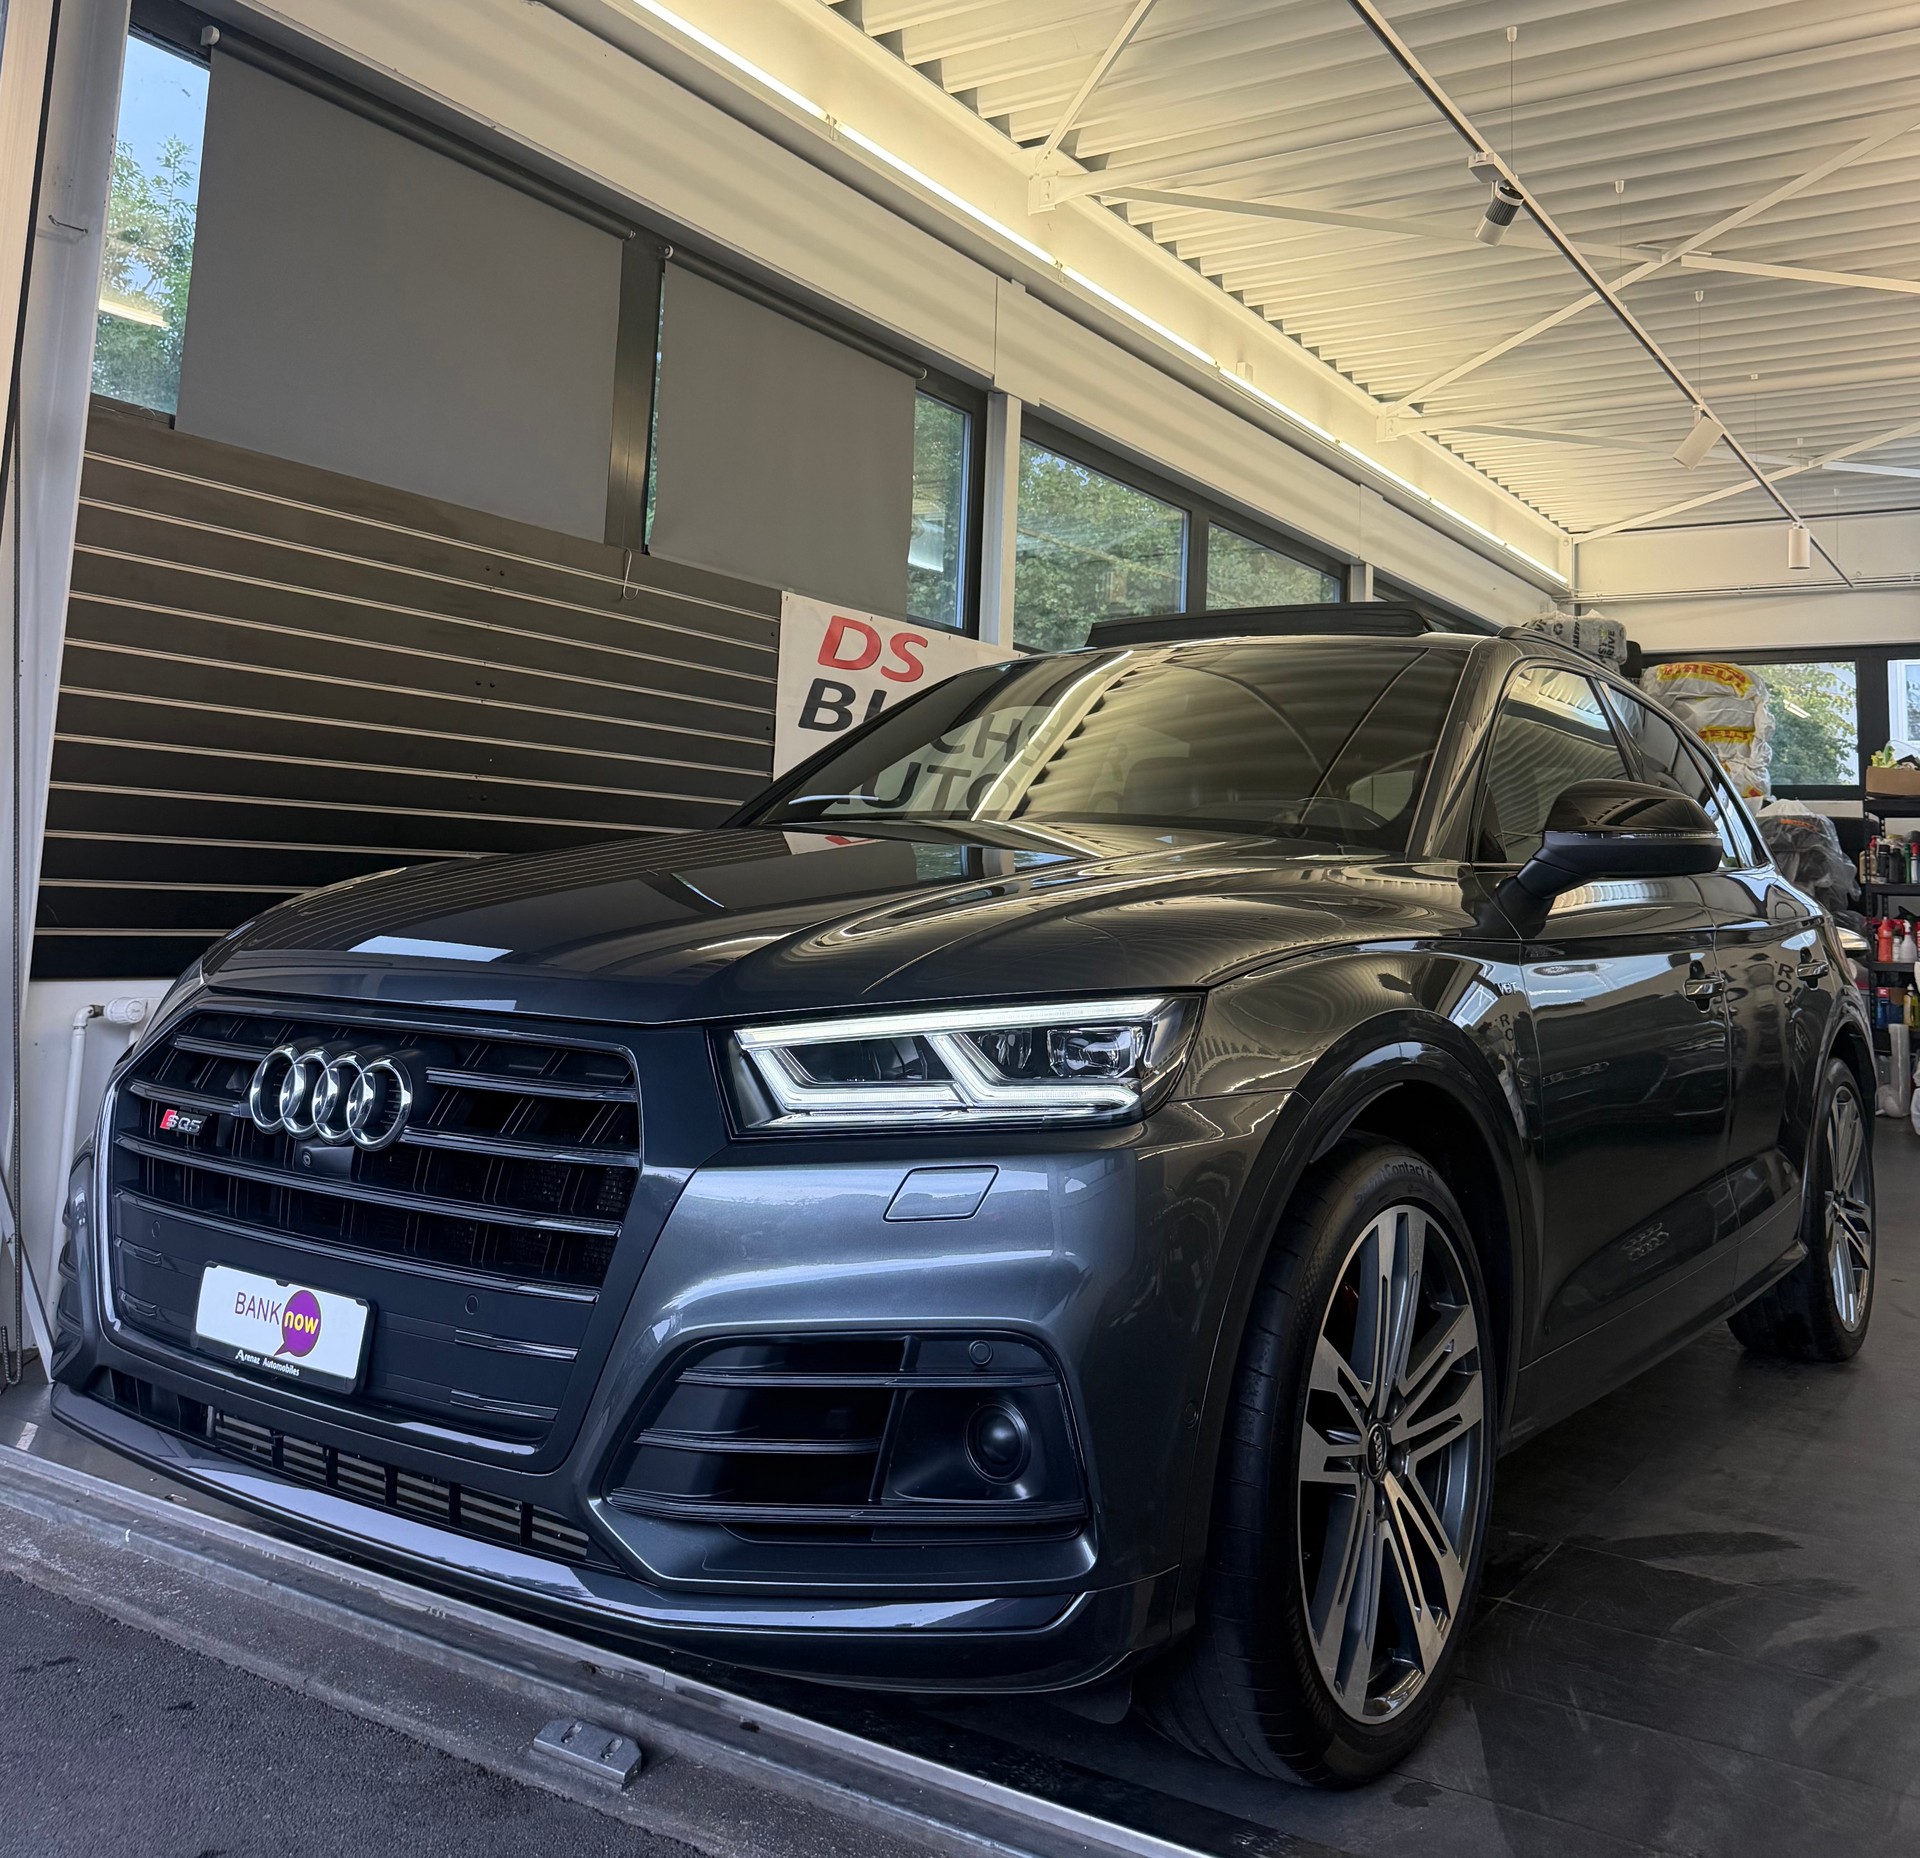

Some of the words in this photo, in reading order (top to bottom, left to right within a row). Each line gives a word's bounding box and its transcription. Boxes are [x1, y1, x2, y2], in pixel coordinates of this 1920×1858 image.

[817, 615, 929, 683] DS
[165, 1114, 203, 1132] SQ5
[234, 1291, 282, 1326] BANK
[284, 1310, 319, 1335] now
[235, 1349, 261, 1366] Arenaz
[262, 1357, 300, 1377] Automobiles
